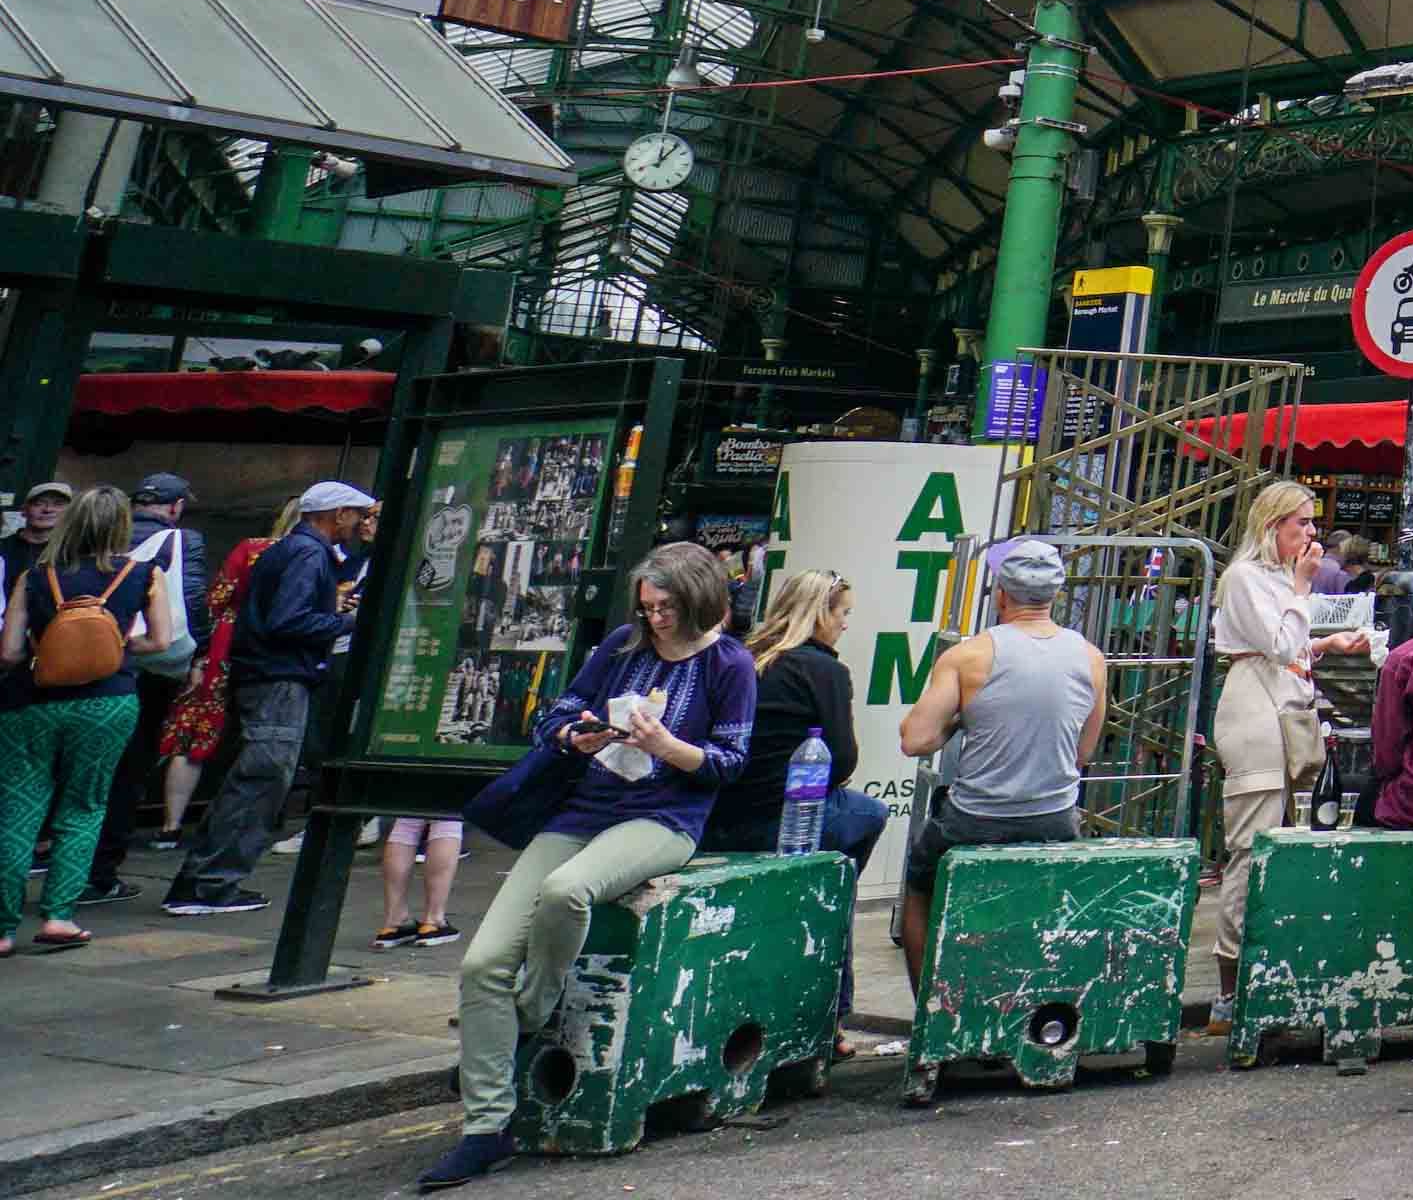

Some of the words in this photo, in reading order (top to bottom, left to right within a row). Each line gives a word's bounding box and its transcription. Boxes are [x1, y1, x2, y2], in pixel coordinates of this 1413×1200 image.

[1252, 290, 1267, 307] Le
[1269, 286, 1311, 305] Marché
[1313, 285, 1328, 302] du
[864, 778, 916, 799] CAS
